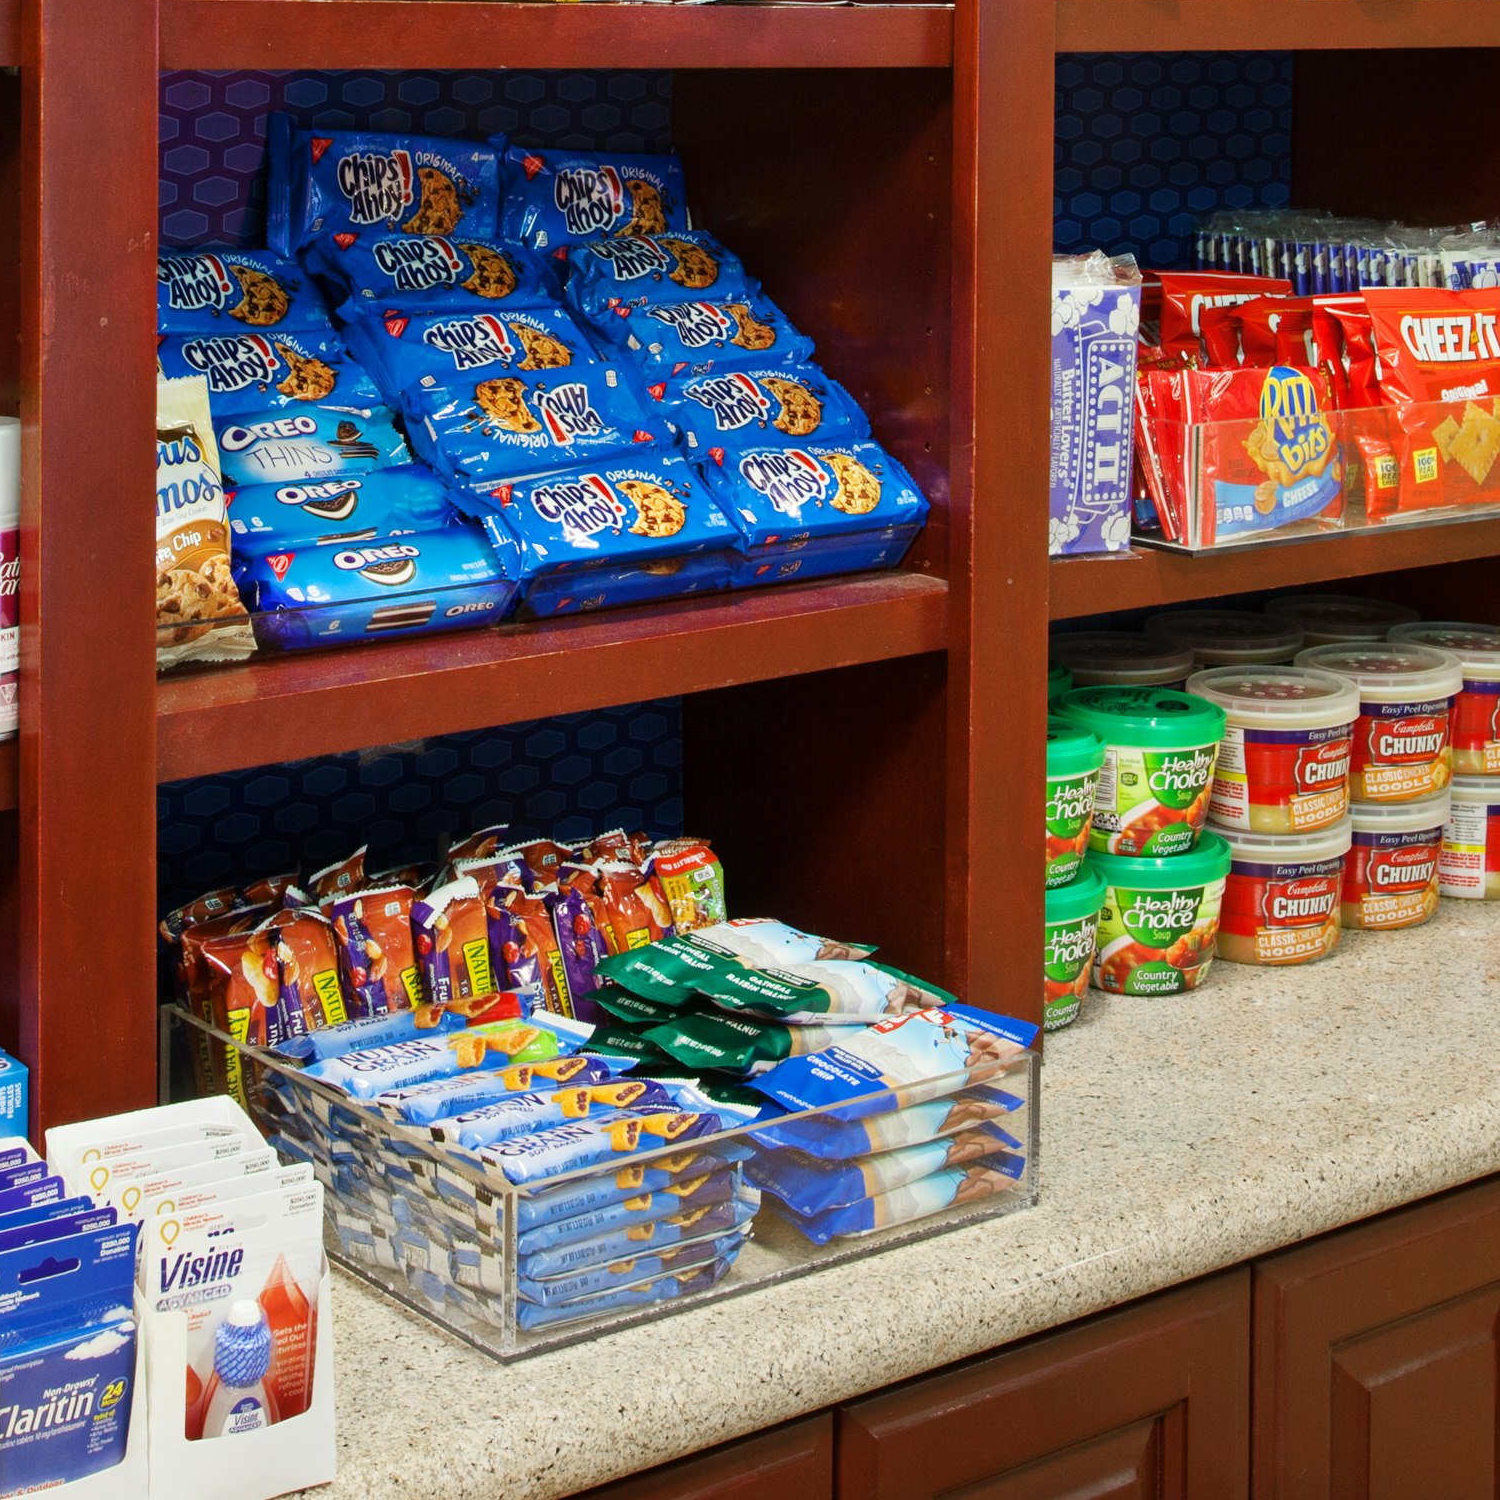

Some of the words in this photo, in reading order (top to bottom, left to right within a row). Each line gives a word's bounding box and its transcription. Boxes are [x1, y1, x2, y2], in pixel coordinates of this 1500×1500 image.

[1061, 368, 1075, 421] Butter
[1097, 357, 1124, 434] ACT
[1261, 375, 1319, 441] RITZ
[221, 417, 318, 452] OREO
[251, 443, 332, 470] THINS
[1059, 423, 1072, 480] Lovers
[1280, 425, 1328, 474] bits
[1094, 441, 1121, 485] II
[276, 477, 362, 504] OREO
[605, 470, 664, 485] ORIGINAL
[530, 482, 598, 518] Chips
[1282, 480, 1319, 507] CHEESE
[334, 543, 422, 569] OREO
[1379, 732, 1444, 757] CHUNKY
[1277, 865, 1294, 876] Easy
[1296, 863, 1311, 874] Peel
[1313, 859, 1341, 875] Opening
[1287, 880, 1328, 896] Campbell's
[1134, 892, 1200, 912] Healthy
[1273, 893, 1335, 919] CHUNKY
[1123, 908, 1194, 928] Choice
[1153, 929, 1171, 941] Soup
[1259, 933, 1296, 949] CLASSIC
[651, 940, 678, 959] RAISIN
[679, 951, 714, 972] WALNUT
[672, 941, 710, 963] OATMEAL
[1259, 939, 1323, 958] NOODLE
[1133, 980, 1179, 992] Vegetable
[1136, 969, 1178, 982] Country
[353, 1042, 441, 1073] GRAIN
[379, 1060, 398, 1073] SOFT
[400, 1052, 432, 1067] BAKED
[806, 1055, 860, 1086] CHOCOLATE
[810, 1066, 835, 1083] CHIP
[159, 1247, 244, 1293] Visine
[43, 1376, 97, 1399] Non-Drowsy
[104, 1381, 123, 1399] 24
